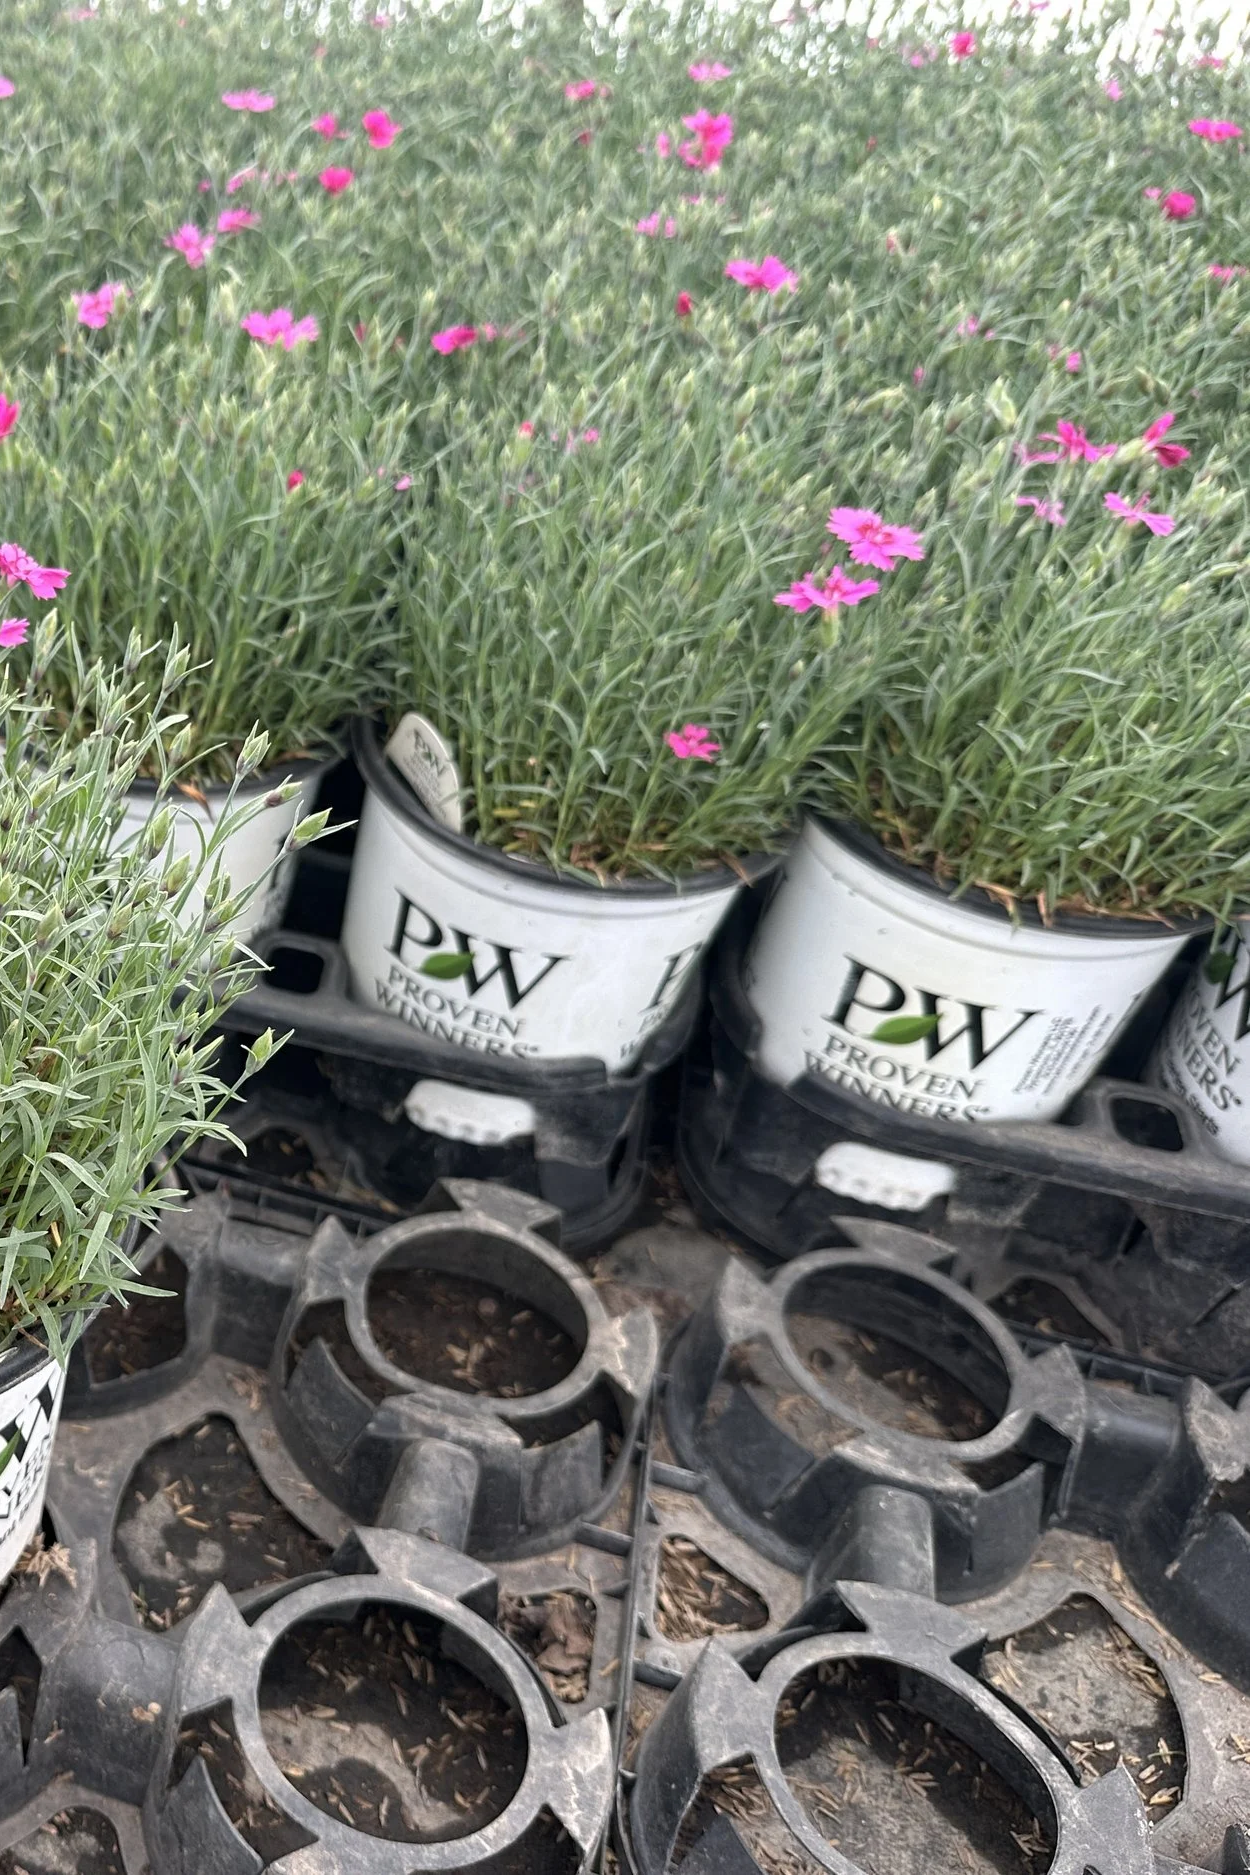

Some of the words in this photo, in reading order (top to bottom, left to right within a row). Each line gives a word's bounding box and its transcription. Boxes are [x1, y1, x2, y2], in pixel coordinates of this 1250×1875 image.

[384, 887, 574, 1010] PW
[388, 965, 526, 1039] PROVEN
[822, 953, 1046, 1071] PW
[823, 1034, 986, 1100] PROVEN
